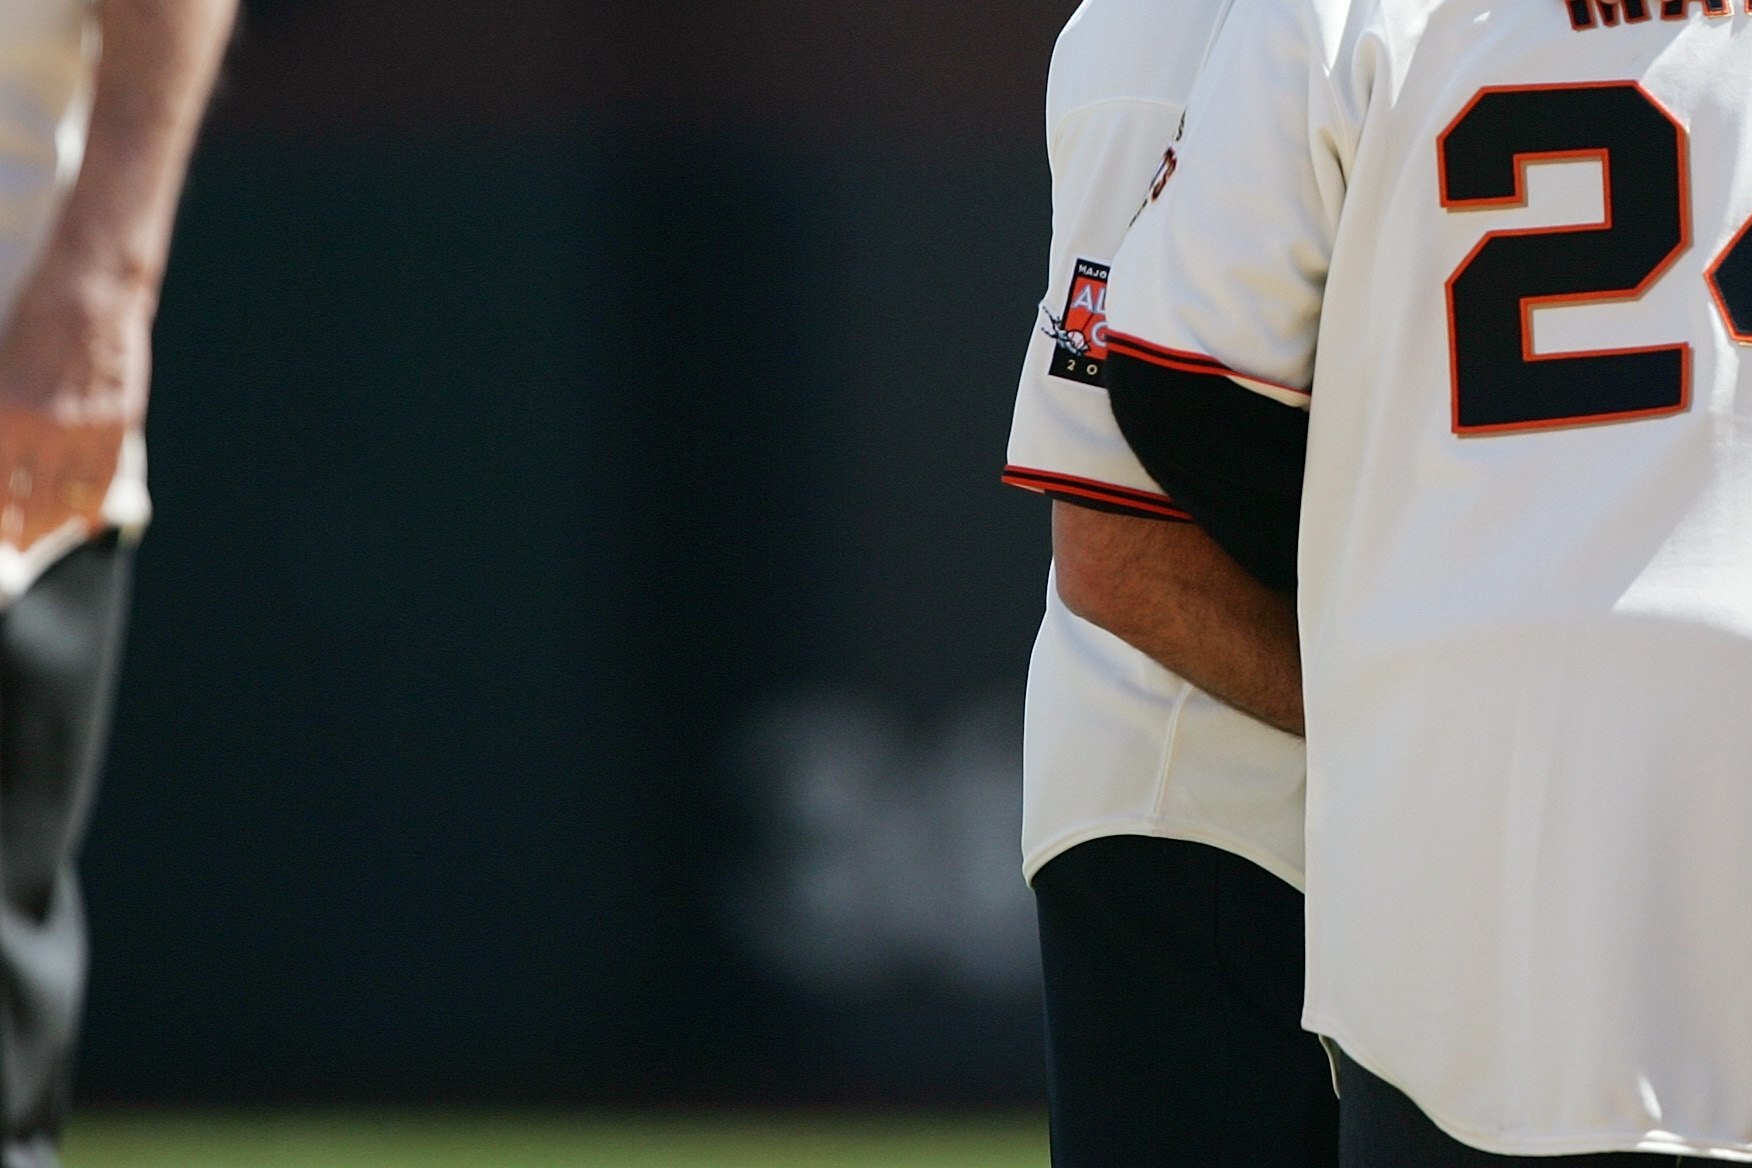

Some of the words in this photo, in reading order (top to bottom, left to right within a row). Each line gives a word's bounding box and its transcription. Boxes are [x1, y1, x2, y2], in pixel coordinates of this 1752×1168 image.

[1078, 264, 1108, 279] MAJO
[1069, 282, 1108, 314] AL
[1066, 359, 1099, 376] 20
